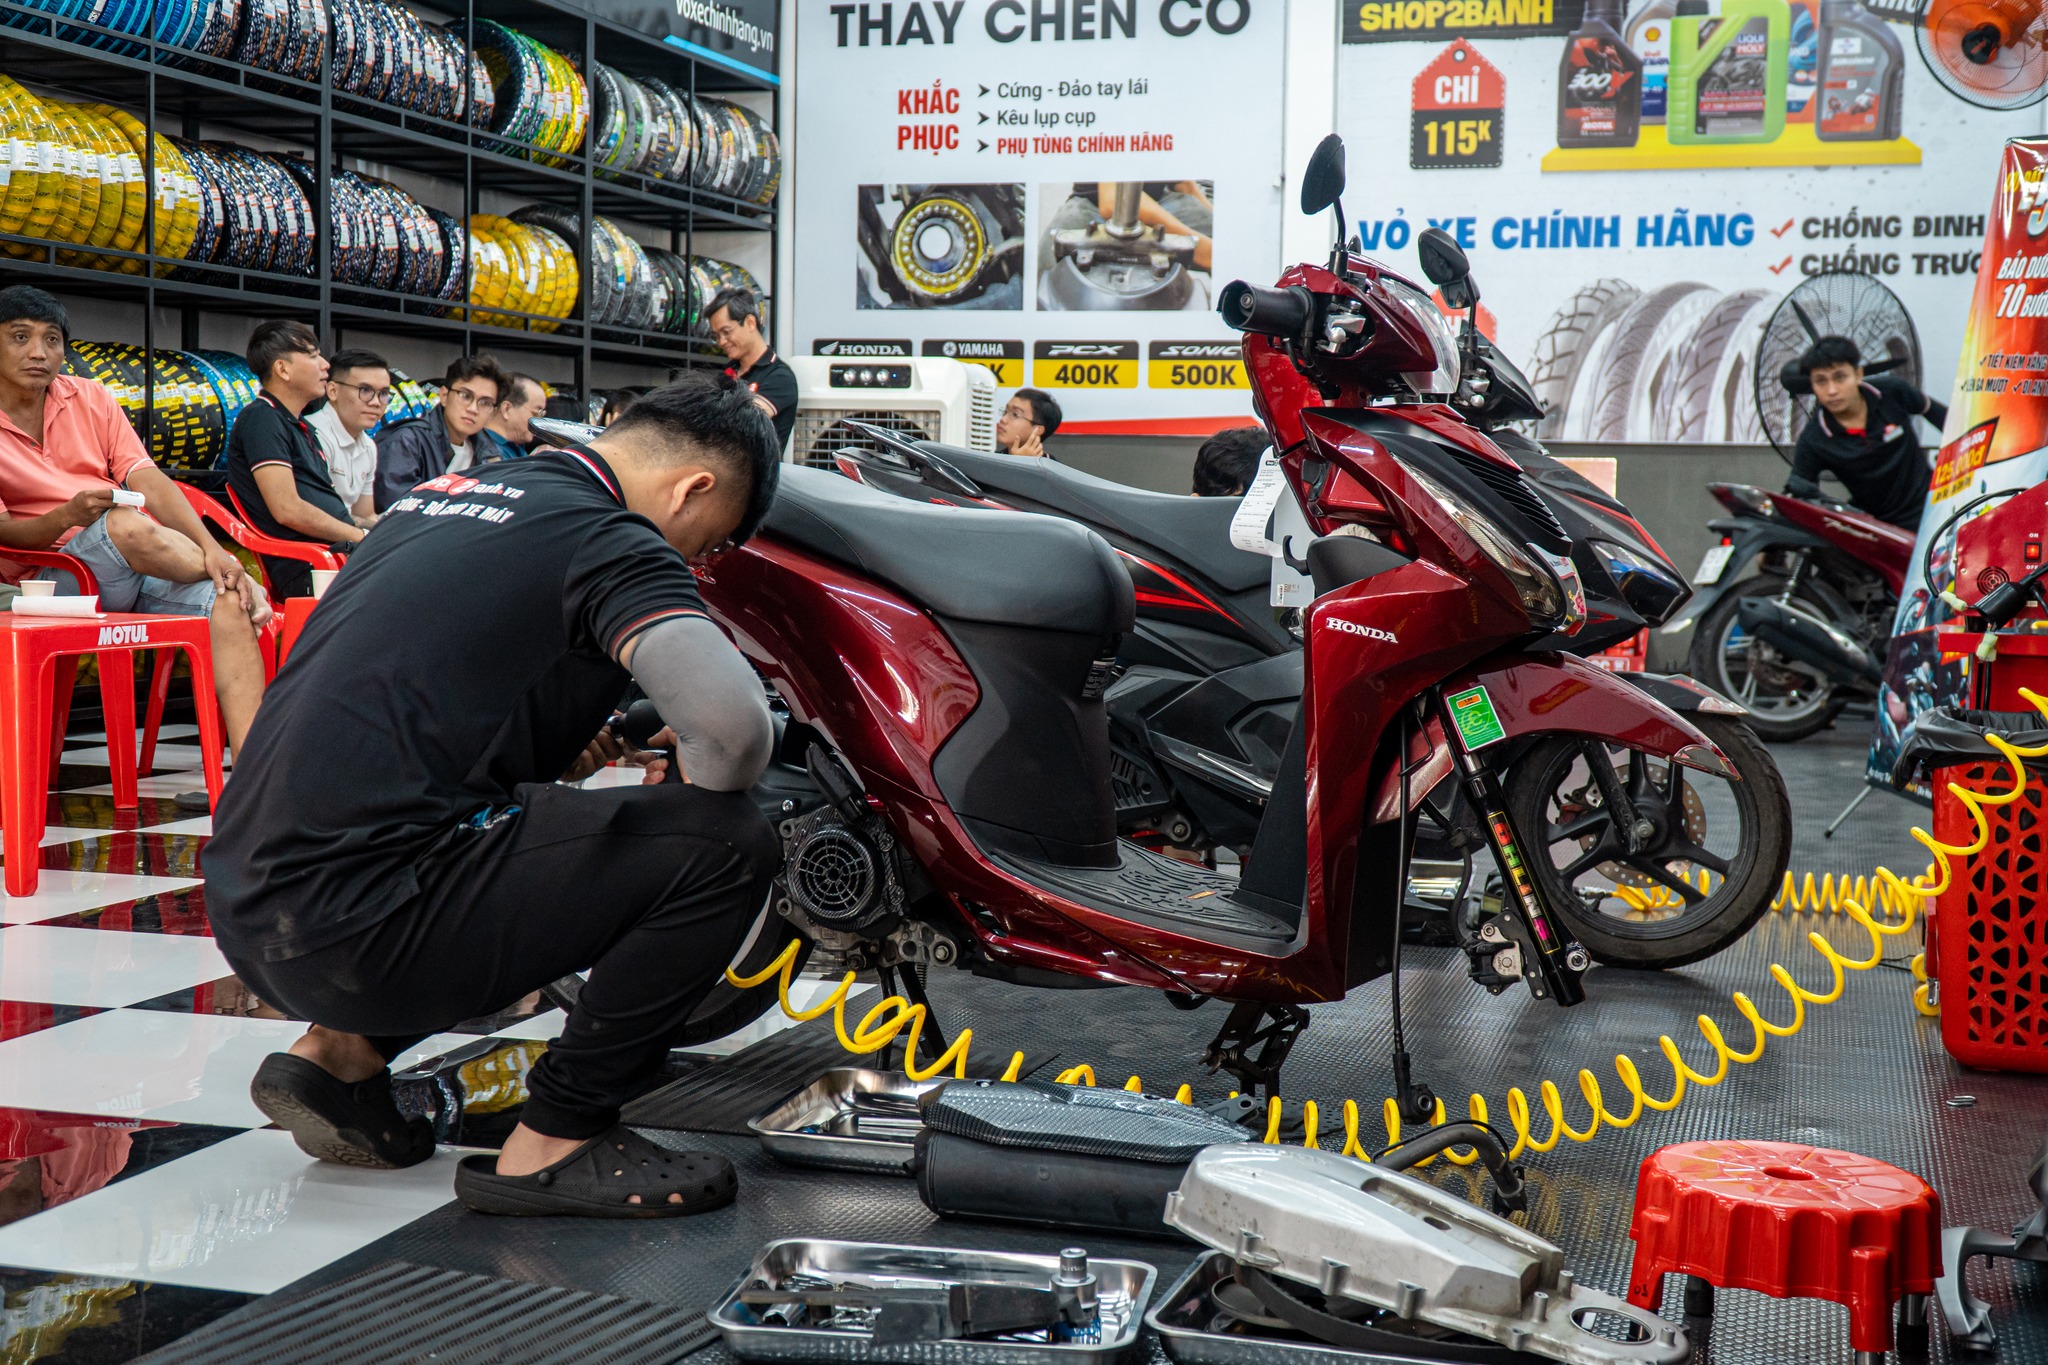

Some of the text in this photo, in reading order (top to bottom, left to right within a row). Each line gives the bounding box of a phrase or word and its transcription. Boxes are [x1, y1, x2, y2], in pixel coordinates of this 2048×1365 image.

[830, 1, 964, 47] THAY
[1360, 0, 1554, 32] SHOP2BANH
[898, 79, 960, 115] KHẮC
[997, 81, 1042, 101] Cứng
[1058, 79, 1092, 97] Đảo
[1097, 80, 1123, 99] tay
[1128, 78, 1148, 95] lái
[1434, 65, 1481, 104] CHỈ
[997, 108, 1096, 128] Kêu lụp cụp
[898, 124, 960, 156] PHỤC
[997, 131, 1174, 157] PHỤ TÙNG CHÍNH HÃNG
[1358, 208, 1411, 250] VỎ
[1492, 209, 1621, 249] CHÍNH
[1636, 207, 1755, 248] HÃNG
[1802, 206, 1985, 239] CHỐNG ĐINH
[1800, 243, 1901, 275] CHỐNG
[1996, 249, 2028, 280] BẢO
[1996, 283, 2027, 318] 10
[839, 344, 906, 356] HONDA
[958, 342, 1004, 357] YAMAHA
[1048, 344, 1124, 356] PCX
[1159, 345, 1243, 357] SONIC
[1055, 363, 1120, 385] 400K
[1171, 364, 1237, 386] 500K
[460, 503, 485, 517] XE
[477, 507, 515, 524] MÁY
[97, 624, 149, 646] MOTUL
[1326, 617, 1399, 644] HONDA
